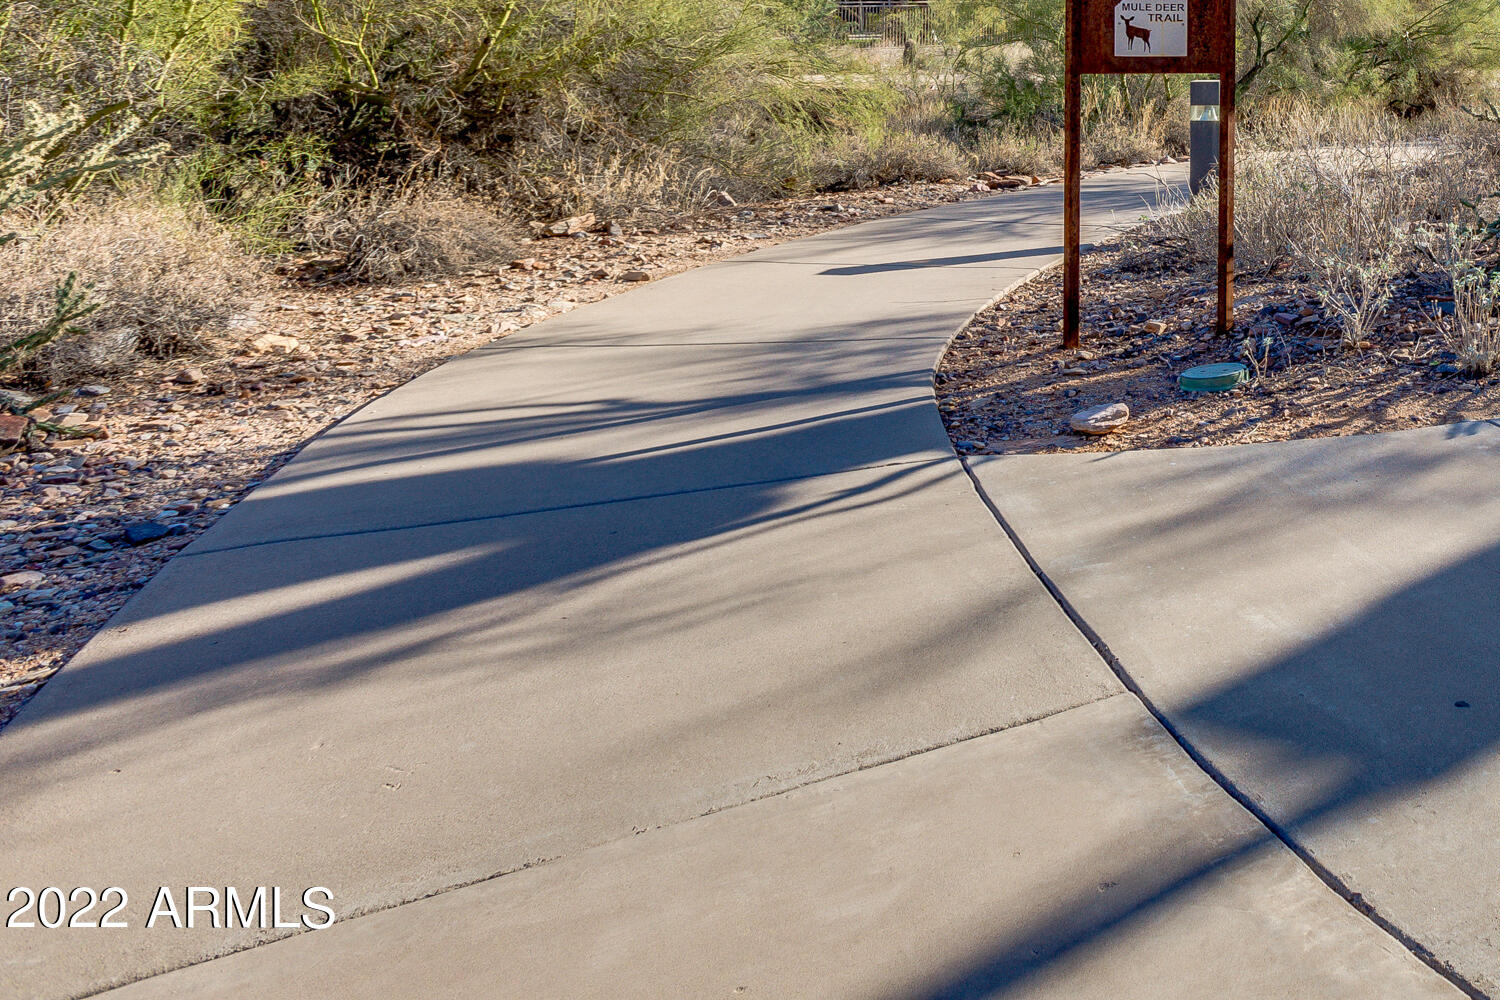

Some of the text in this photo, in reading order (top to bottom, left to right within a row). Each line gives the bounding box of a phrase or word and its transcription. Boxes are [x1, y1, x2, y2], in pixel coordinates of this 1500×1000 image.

[1122, 3, 1185, 11] MULE DEER
[1148, 13, 1183, 22] TRAIL
